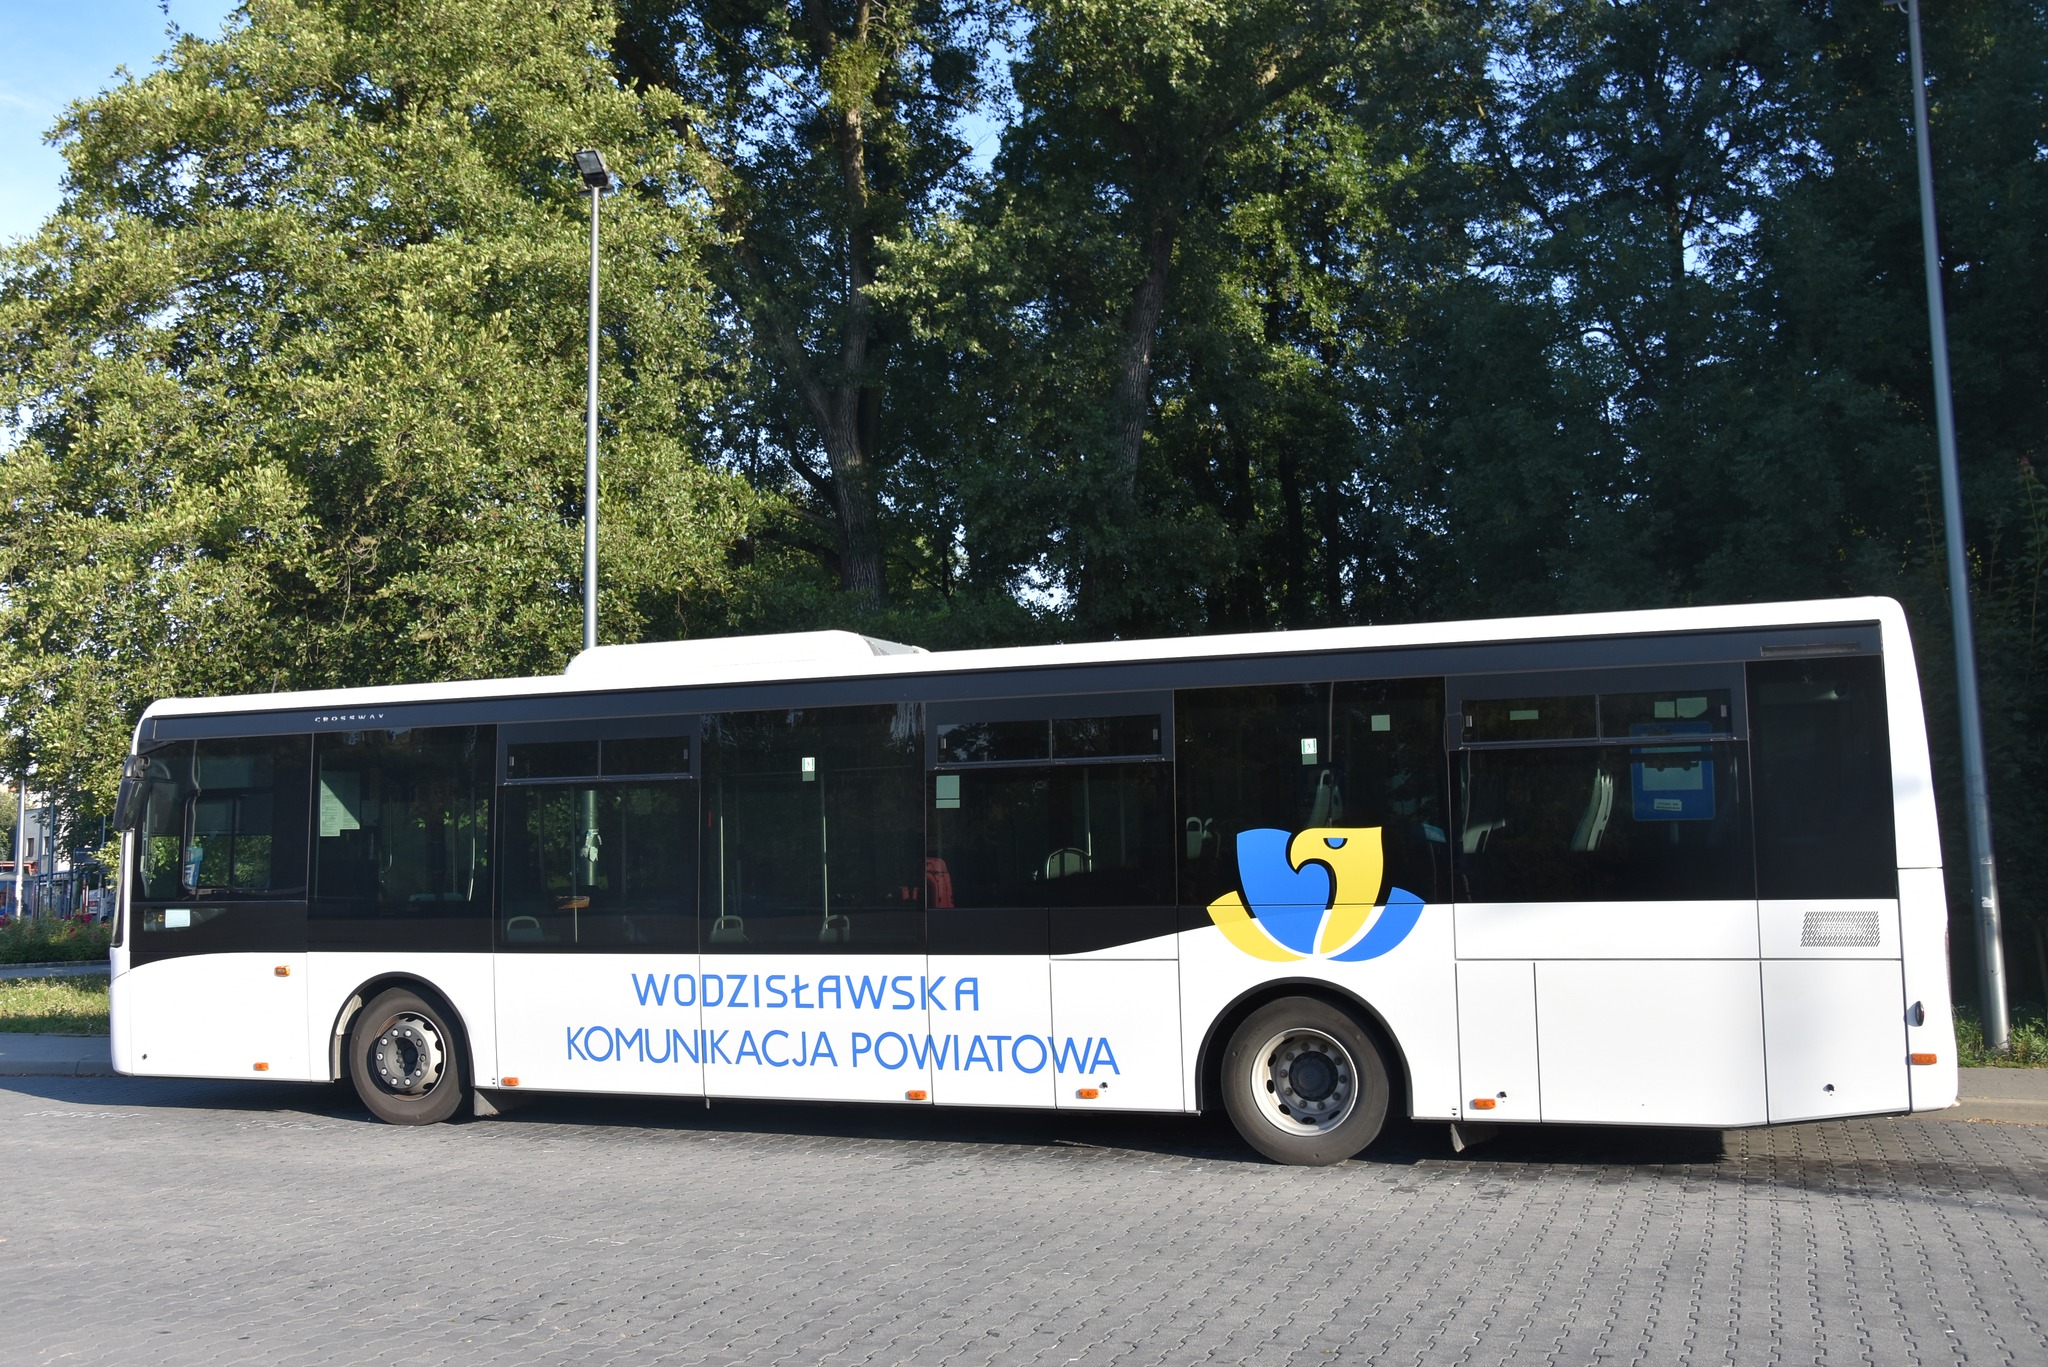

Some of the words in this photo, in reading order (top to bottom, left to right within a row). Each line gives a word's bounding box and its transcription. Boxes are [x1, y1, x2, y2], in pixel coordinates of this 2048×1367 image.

[314, 713, 384, 723] CROSSWAY
[631, 973, 980, 1011] WODZISŁAWSKA
[567, 1026, 838, 1068] KOMUNIKACJA
[851, 1031, 1121, 1075] POWIATOWA
